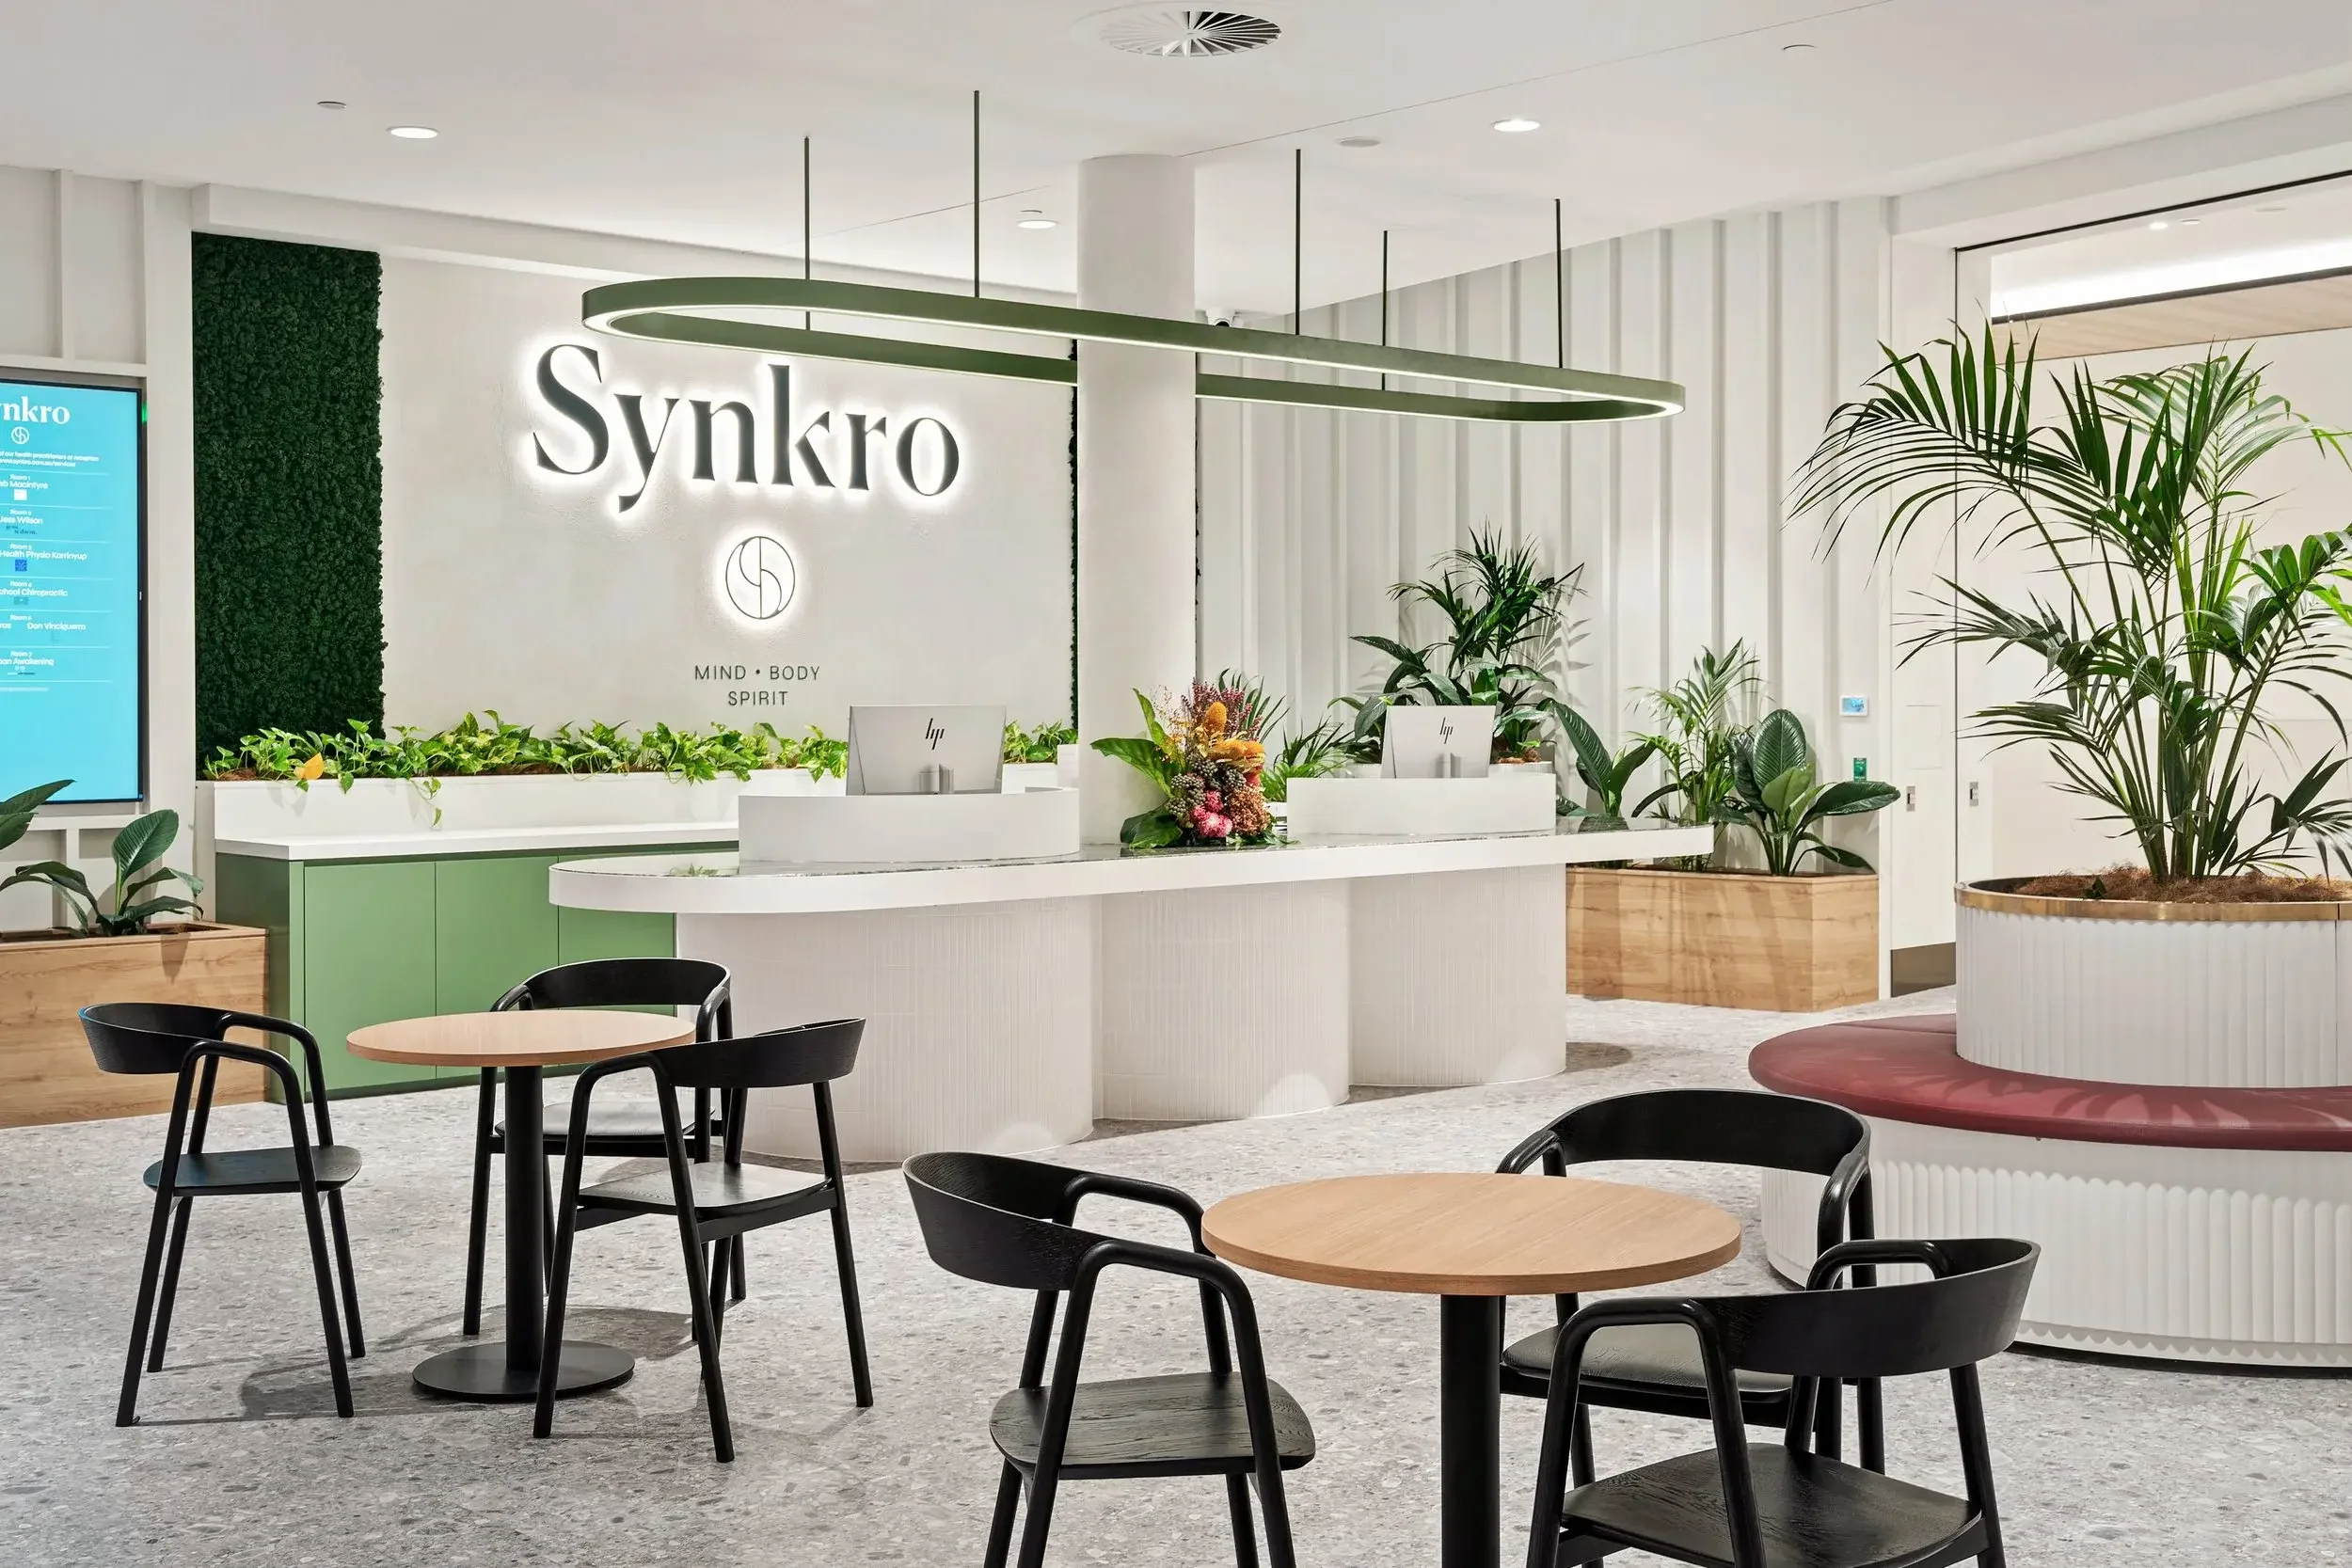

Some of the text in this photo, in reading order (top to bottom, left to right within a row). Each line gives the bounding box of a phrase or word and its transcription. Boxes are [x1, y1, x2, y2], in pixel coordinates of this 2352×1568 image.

[0, 396, 71, 424] nkro
[533, 344, 960, 513] Synkro
[694, 665, 819, 680] MIND BODY
[727, 690, 788, 706] SPIRIT
[925, 718, 945, 751] hp
[1439, 717, 1454, 744] hp
